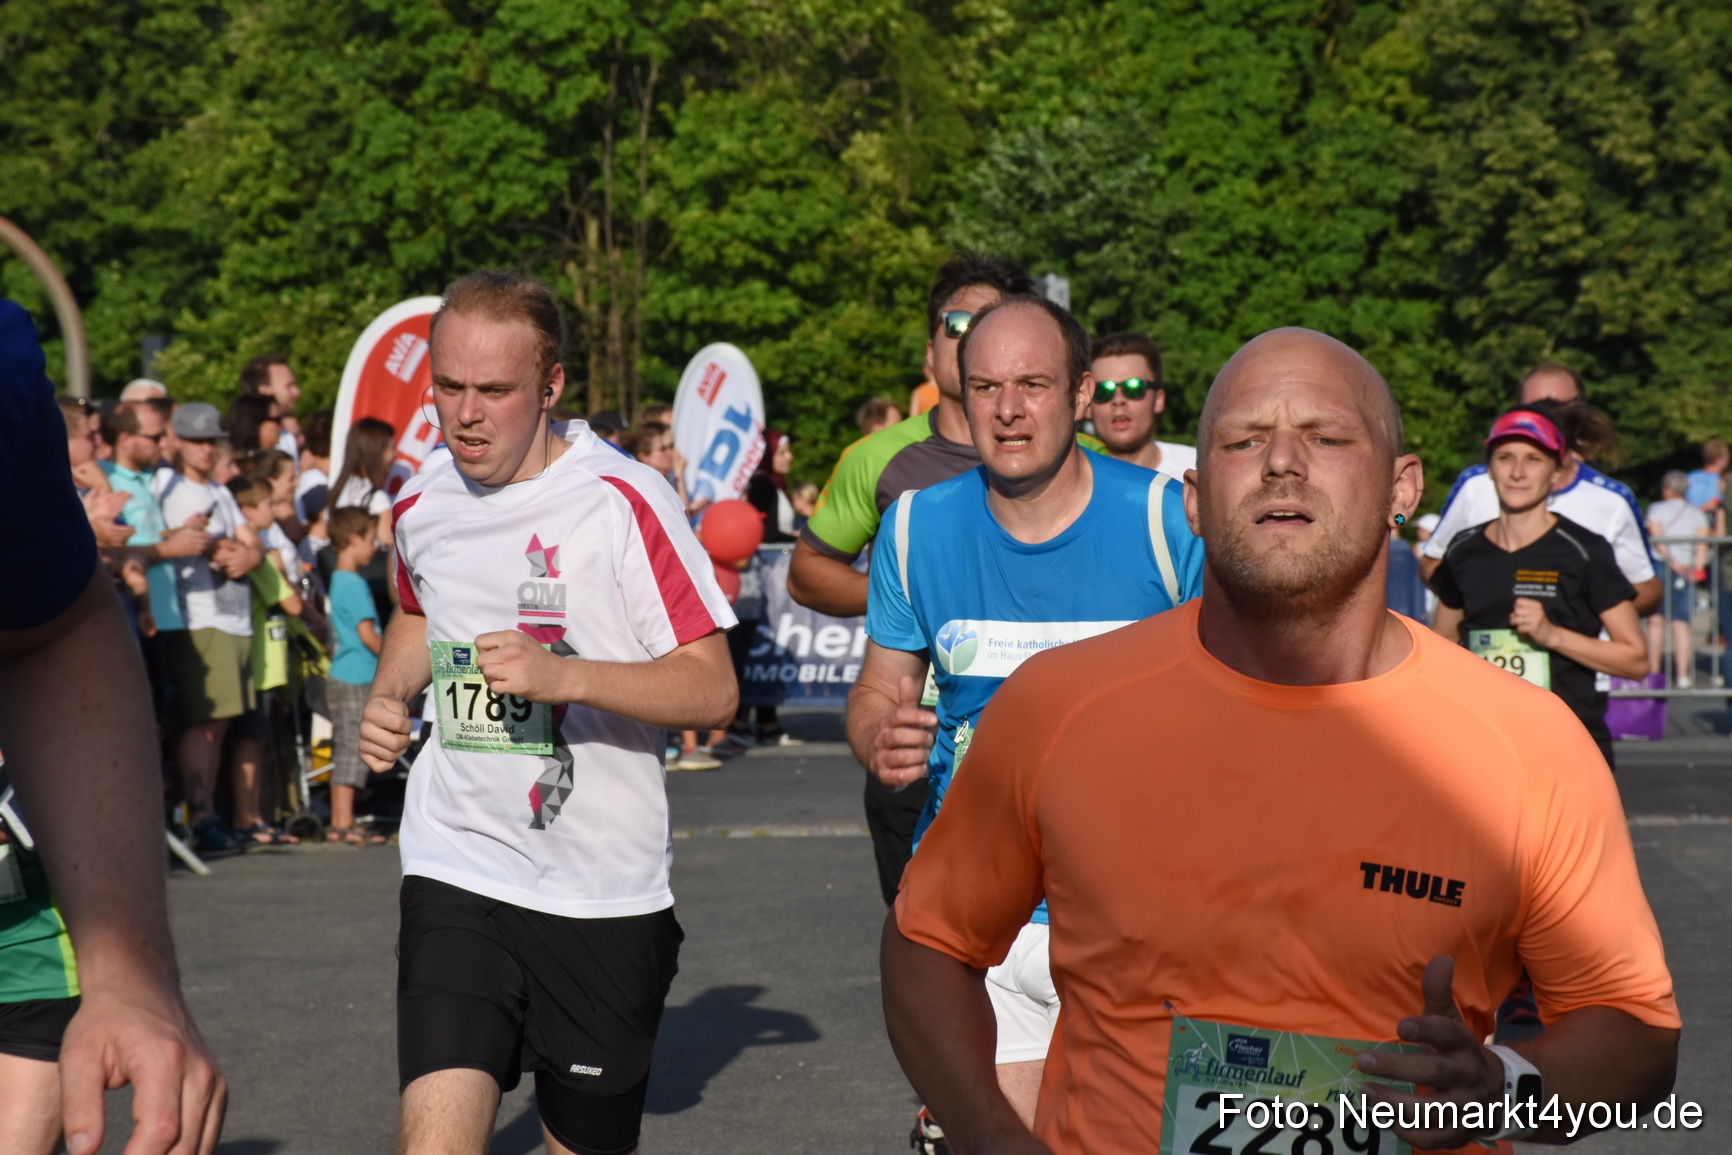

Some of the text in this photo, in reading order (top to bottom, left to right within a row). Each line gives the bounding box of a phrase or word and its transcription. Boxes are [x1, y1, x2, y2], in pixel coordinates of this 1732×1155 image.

[384, 333, 418, 377] AVIA
[988, 637, 1014, 649] Freie
[988, 650, 998, 660] im
[1000, 651, 1022, 661] Haus
[1484, 655, 1525, 677] 29
[446, 662, 482, 675] firmenla
[744, 663, 862, 683] MOBILE
[446, 681, 532, 723] 1789
[460, 722, 515, 734] Schöll David
[502, 735, 524, 743] GmbH
[1360, 861, 1466, 902] THULE
[1206, 1058, 1307, 1088] firmenlauf
[1189, 1090, 1381, 1155] 2289
